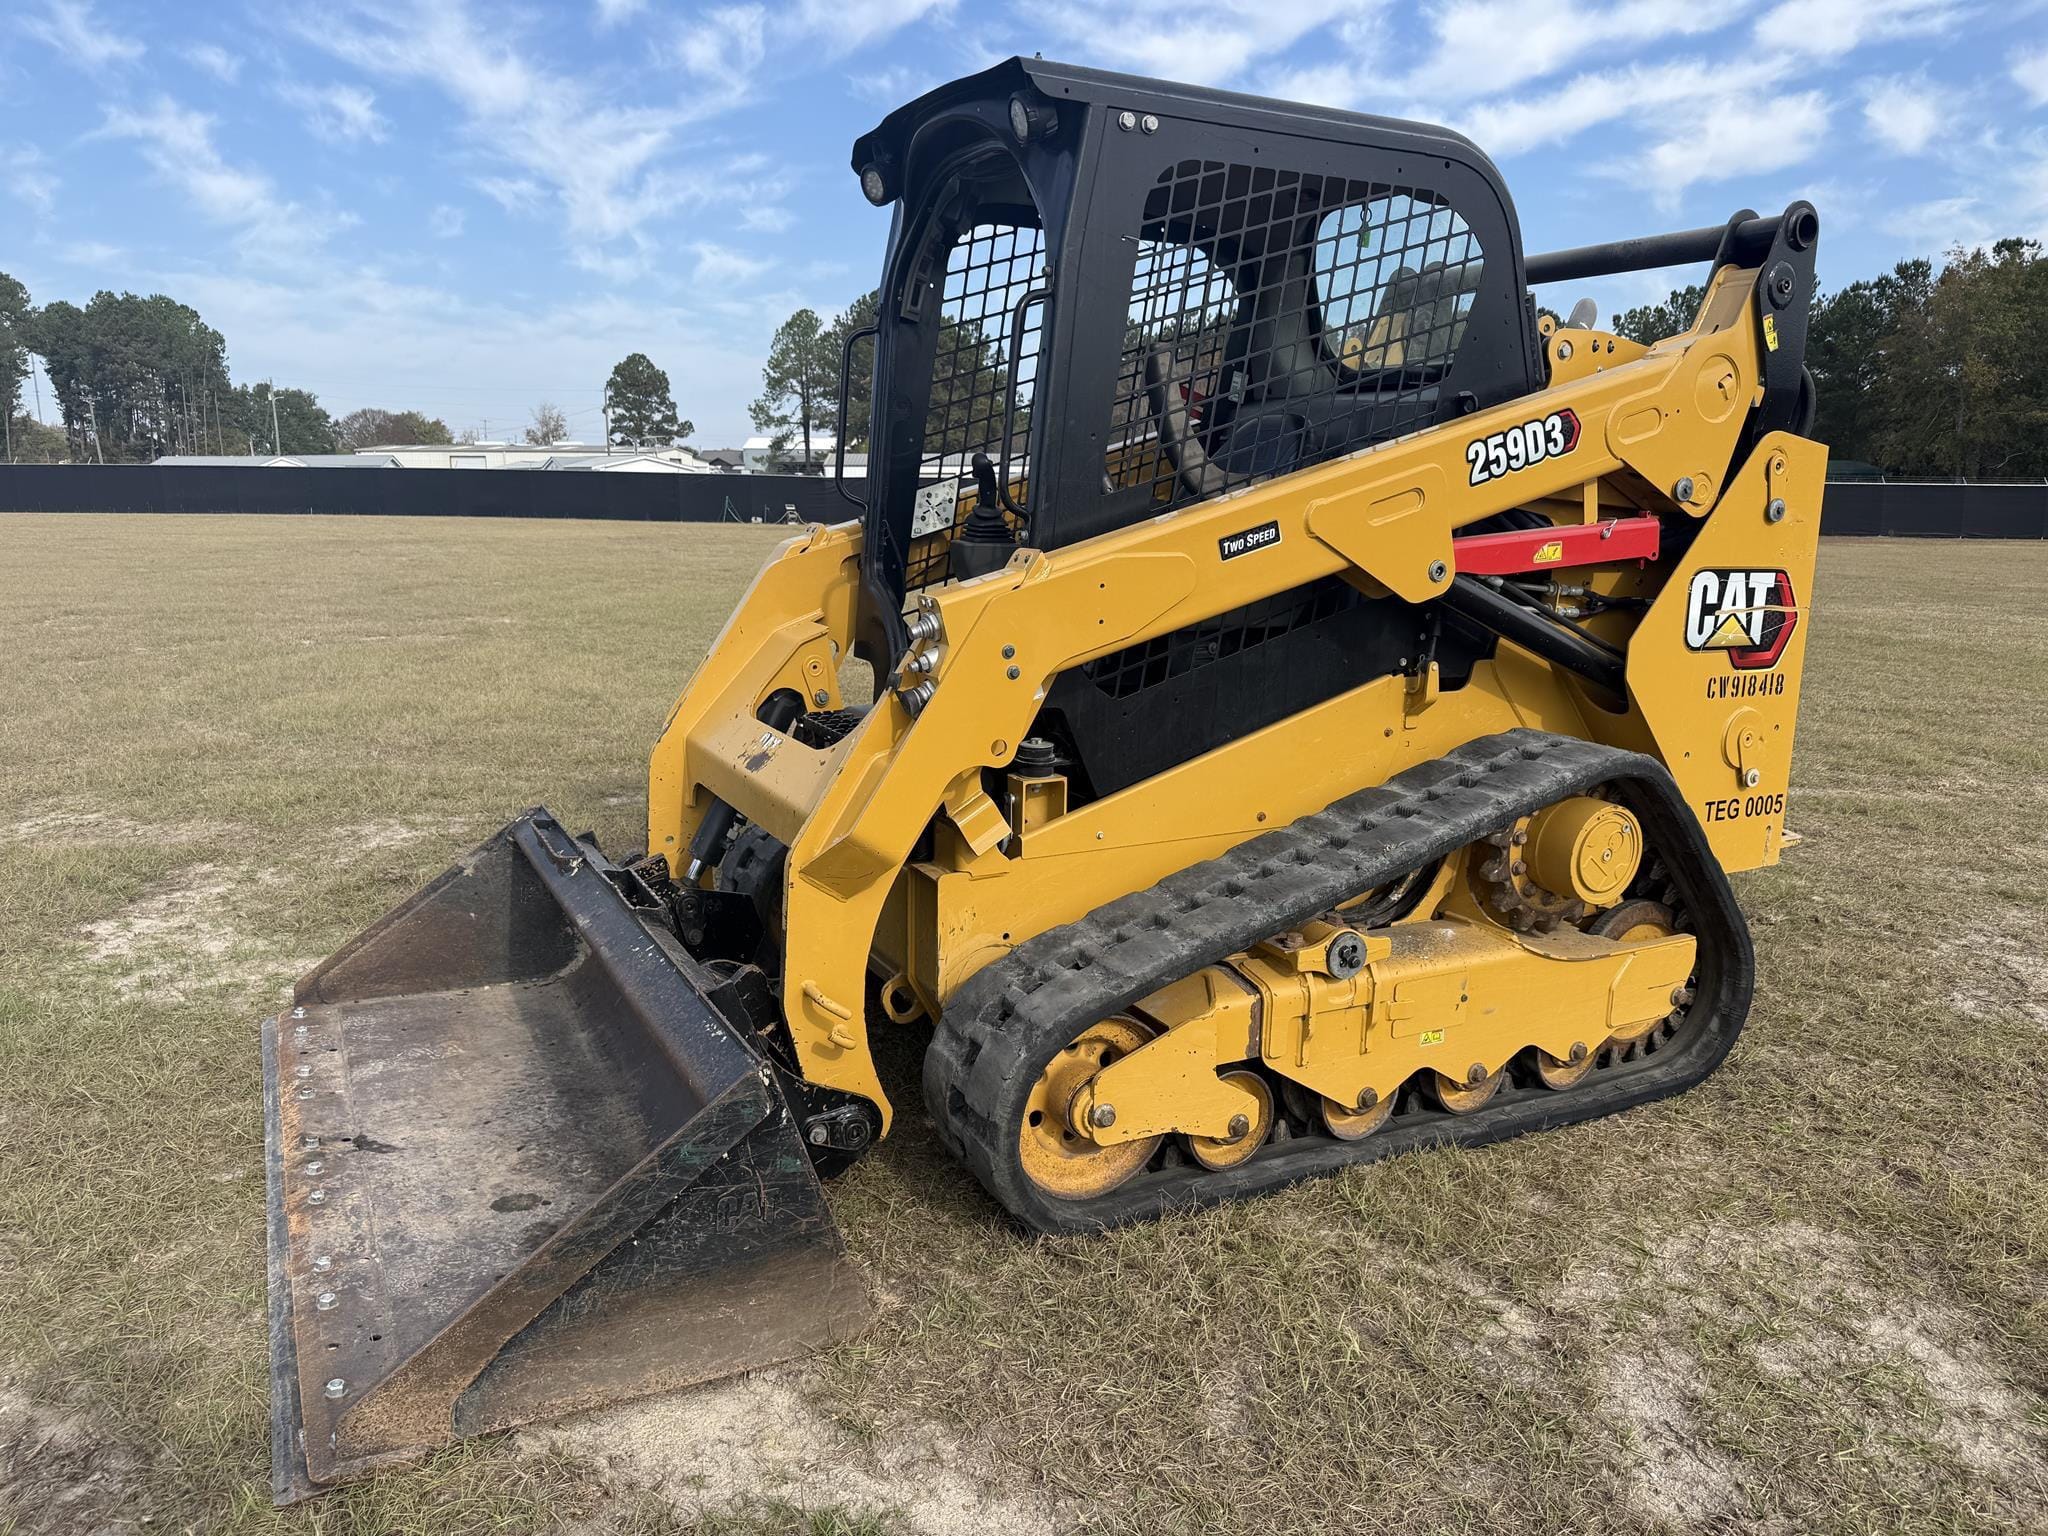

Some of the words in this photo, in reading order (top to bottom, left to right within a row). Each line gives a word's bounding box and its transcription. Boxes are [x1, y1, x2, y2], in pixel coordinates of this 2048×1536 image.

[1467, 414, 1565, 485] 259D3
[1686, 570, 1777, 648] CAT
[1706, 673, 1785, 700] CW918418
[1705, 798, 1740, 823] TEG
[1744, 794, 1784, 818] 0005
